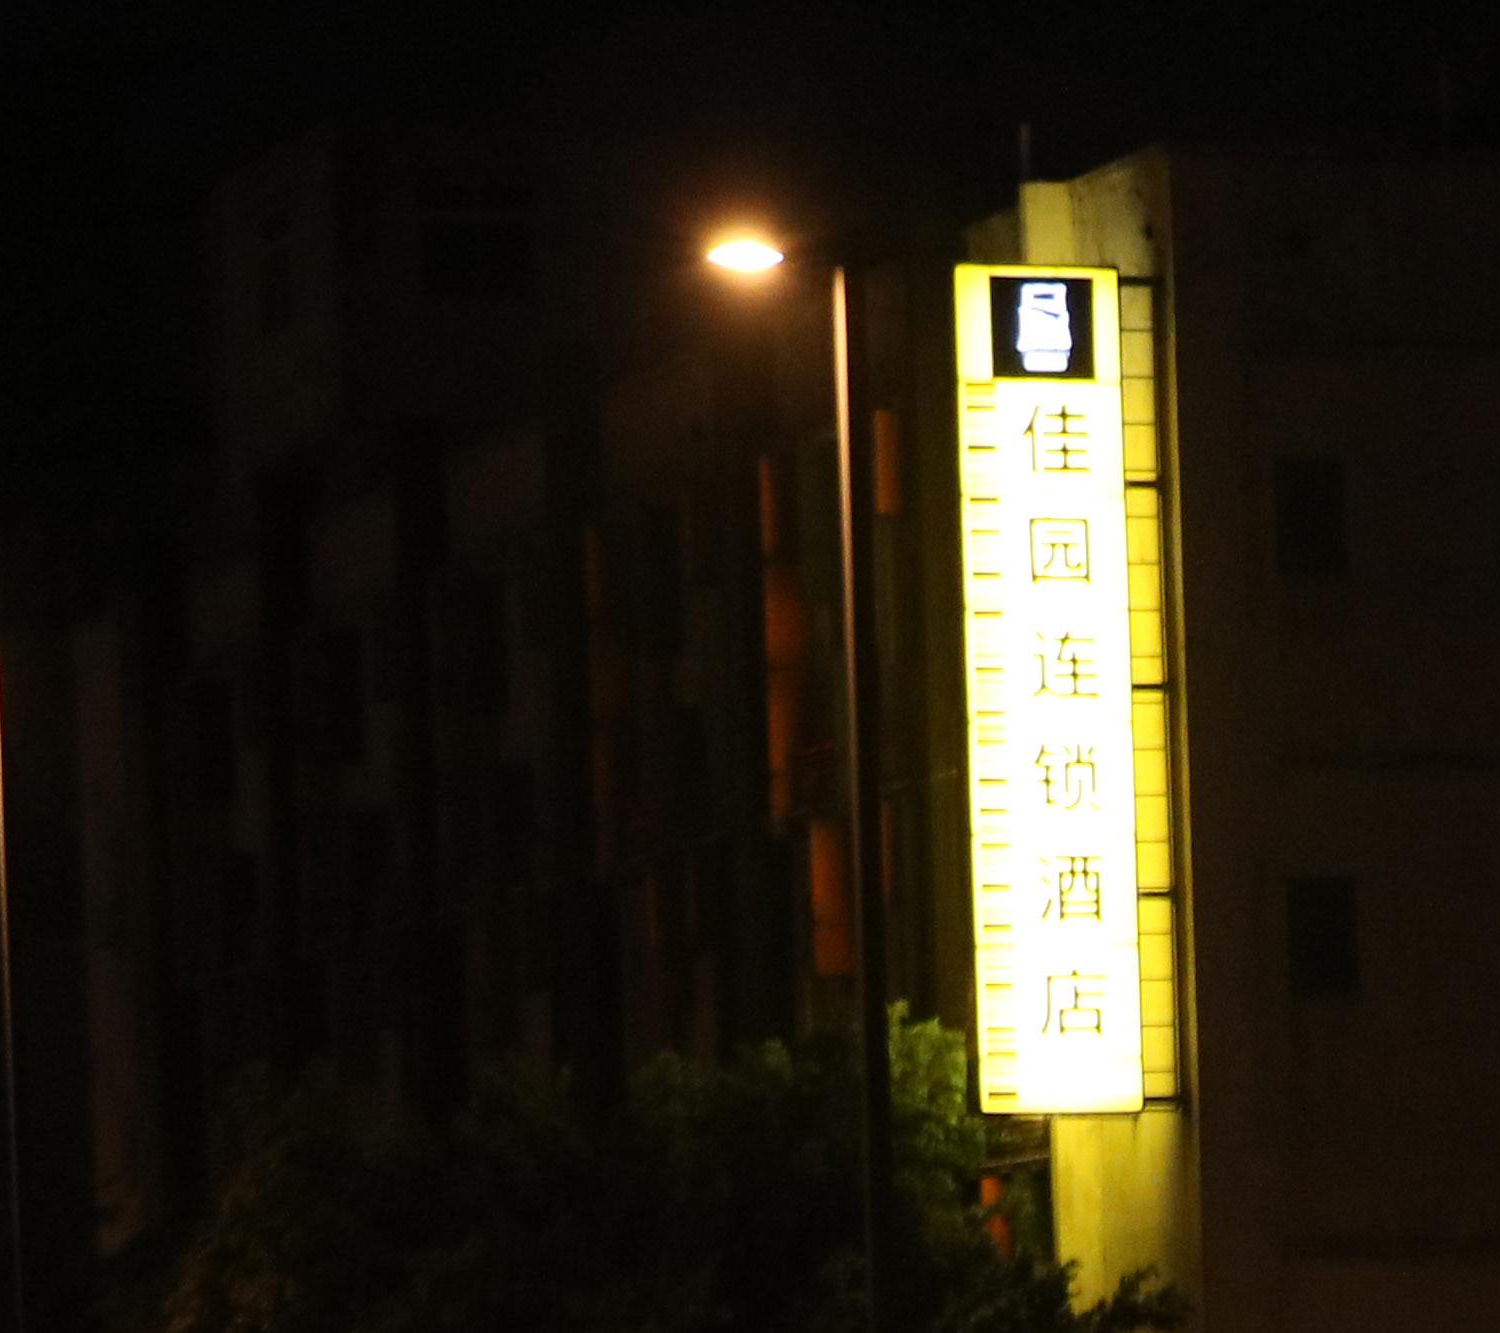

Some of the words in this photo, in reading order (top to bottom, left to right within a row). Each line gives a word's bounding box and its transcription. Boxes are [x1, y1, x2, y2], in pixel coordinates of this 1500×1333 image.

[1023, 405, 1106, 1035] 佳园连锁酒店
